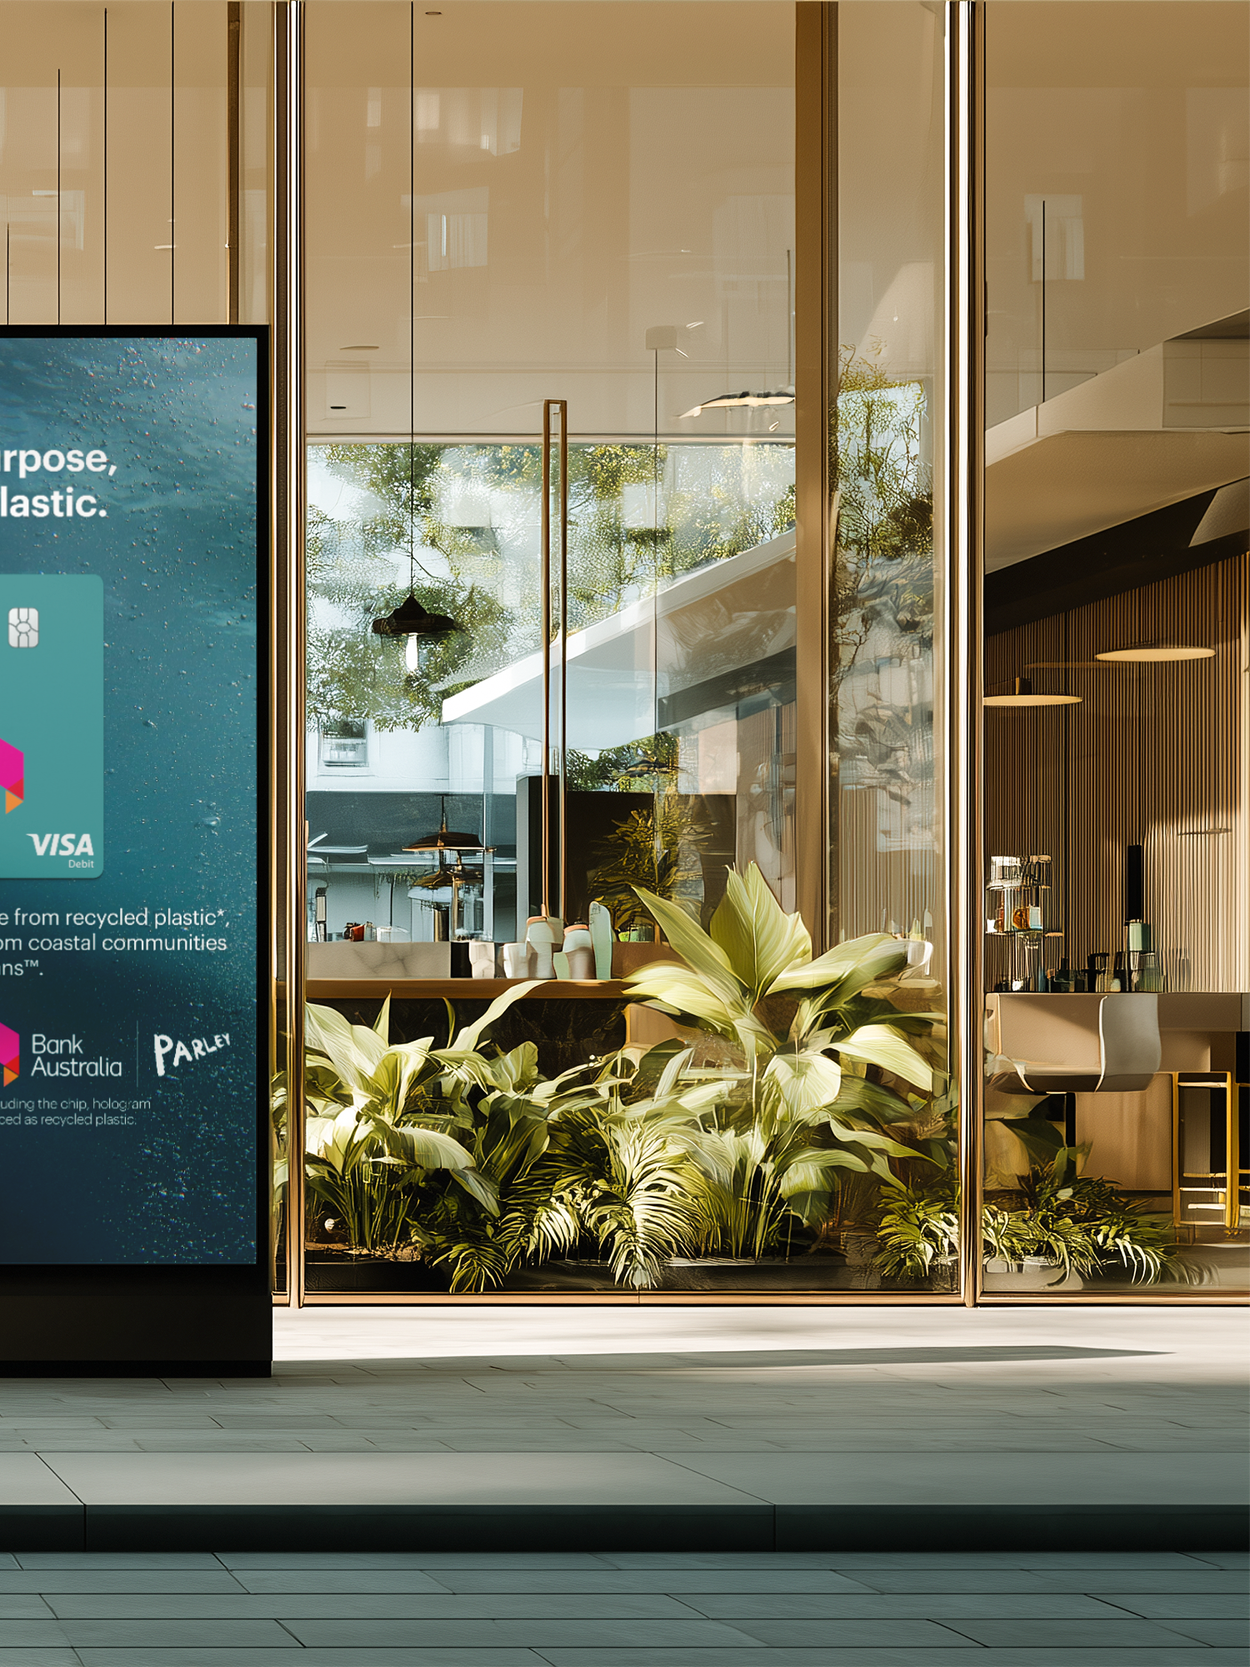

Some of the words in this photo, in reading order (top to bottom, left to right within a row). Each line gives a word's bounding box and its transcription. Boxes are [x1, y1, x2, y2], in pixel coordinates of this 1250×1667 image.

[26, 833, 95, 857] VISA
[68, 859, 95, 869] Debit
[14, 907, 59, 926] from
[66, 907, 148, 930] recycled
[28, 932, 96, 952] coastal
[102, 933, 228, 952] communities
[31, 1033, 84, 1055] Bank
[30, 1056, 122, 1077] Australia
[37, 1098, 58, 1110] the
[60, 1098, 90, 1112] chip,
[92, 1097, 152, 1112] hologram
[24, 1116, 38, 1126] as
[40, 1112, 93, 1127] recycled
[95, 1112, 138, 1127] plastic.
